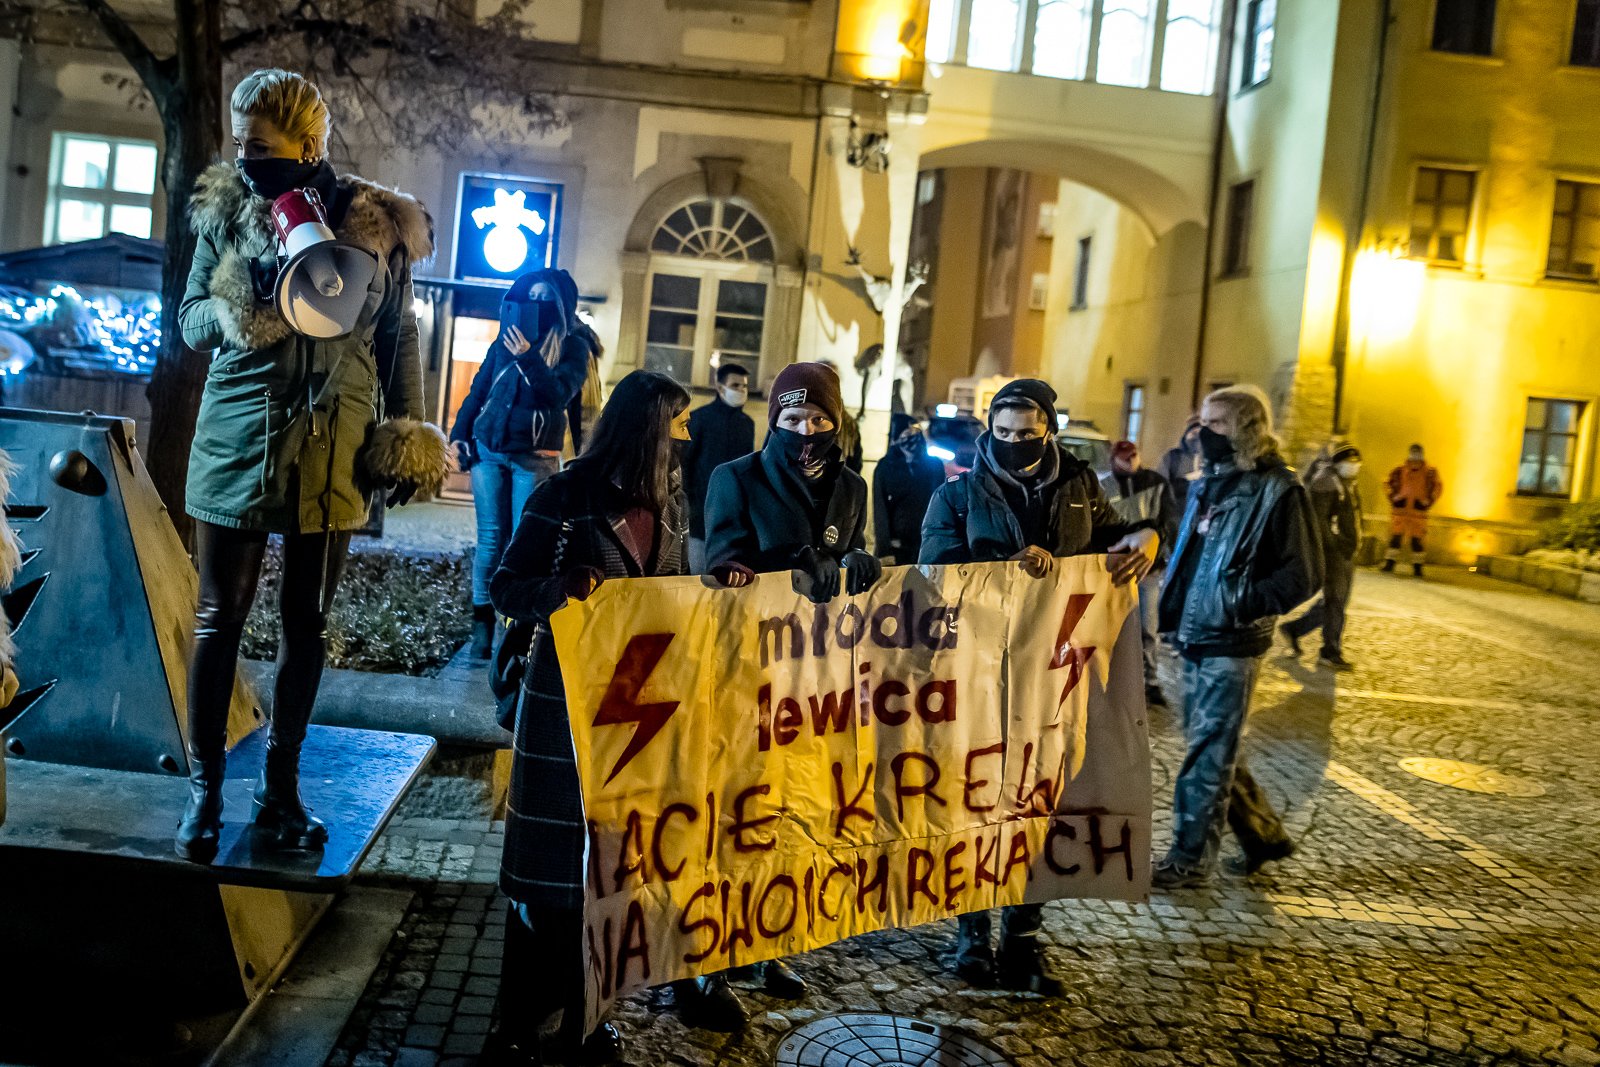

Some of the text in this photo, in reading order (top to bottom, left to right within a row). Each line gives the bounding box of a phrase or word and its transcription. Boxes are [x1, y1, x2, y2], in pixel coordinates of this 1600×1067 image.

[758, 661, 957, 752] lewica
[831, 742, 1066, 838] KREW
[586, 900, 650, 1000] NA
[679, 862, 888, 963] SWOICH
